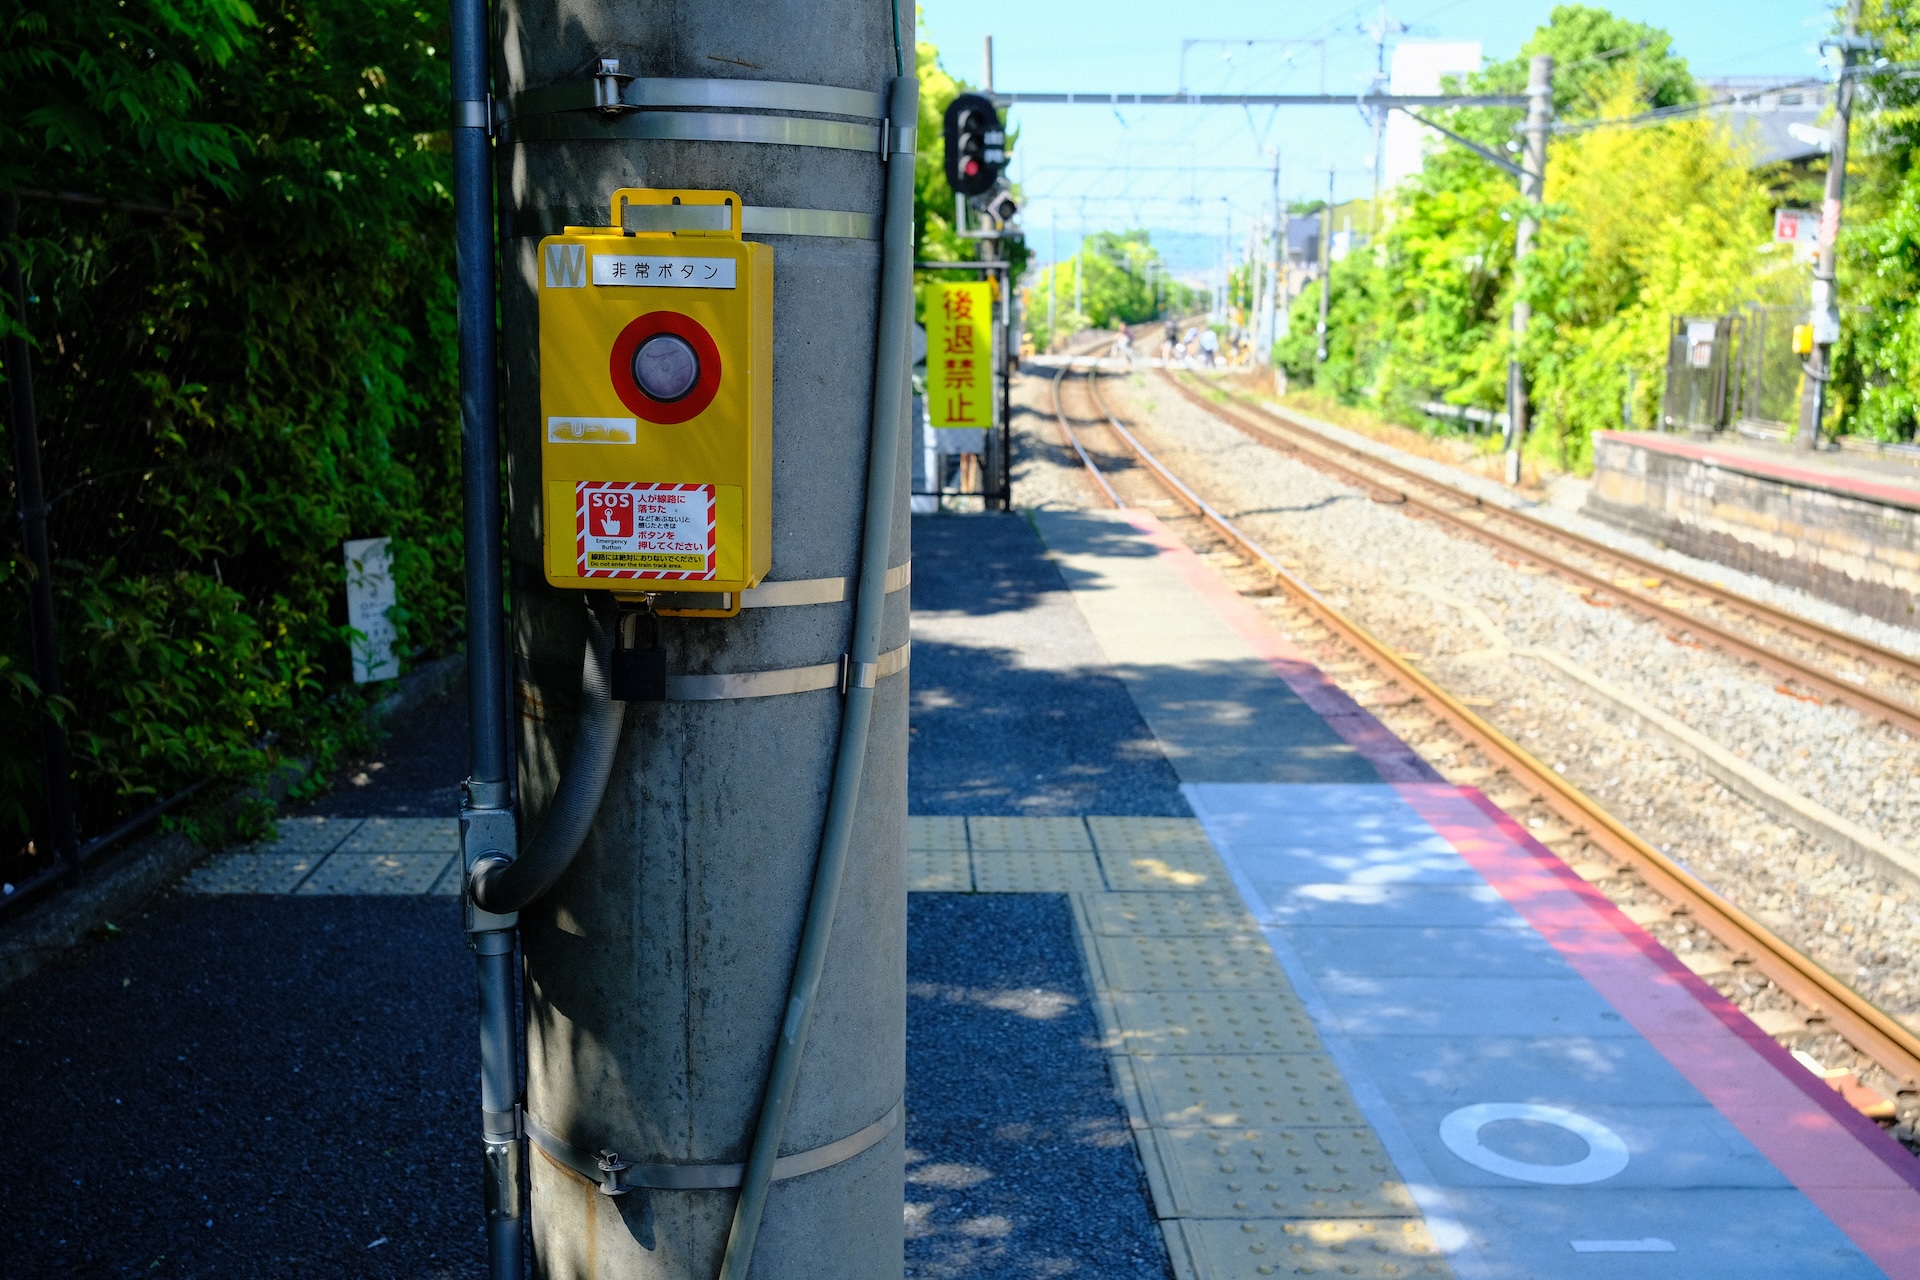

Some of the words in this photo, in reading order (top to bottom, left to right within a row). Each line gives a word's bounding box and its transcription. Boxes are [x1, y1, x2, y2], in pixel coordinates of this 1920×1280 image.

[612, 262, 718, 279] 非常ボタン
[944, 289, 975, 422] 後退禁止
[592, 493, 630, 508] SOS
[638, 494, 686, 504] 人が線路に
[638, 504, 667, 514] 落ちた
[638, 522, 677, 530] 感じたときは
[638, 531, 675, 541] ボタンを
[596, 538, 628, 546] Emergency
[638, 541, 703, 551] 押してください
[591, 553, 702, 563] 線路には絶対におりないでください
